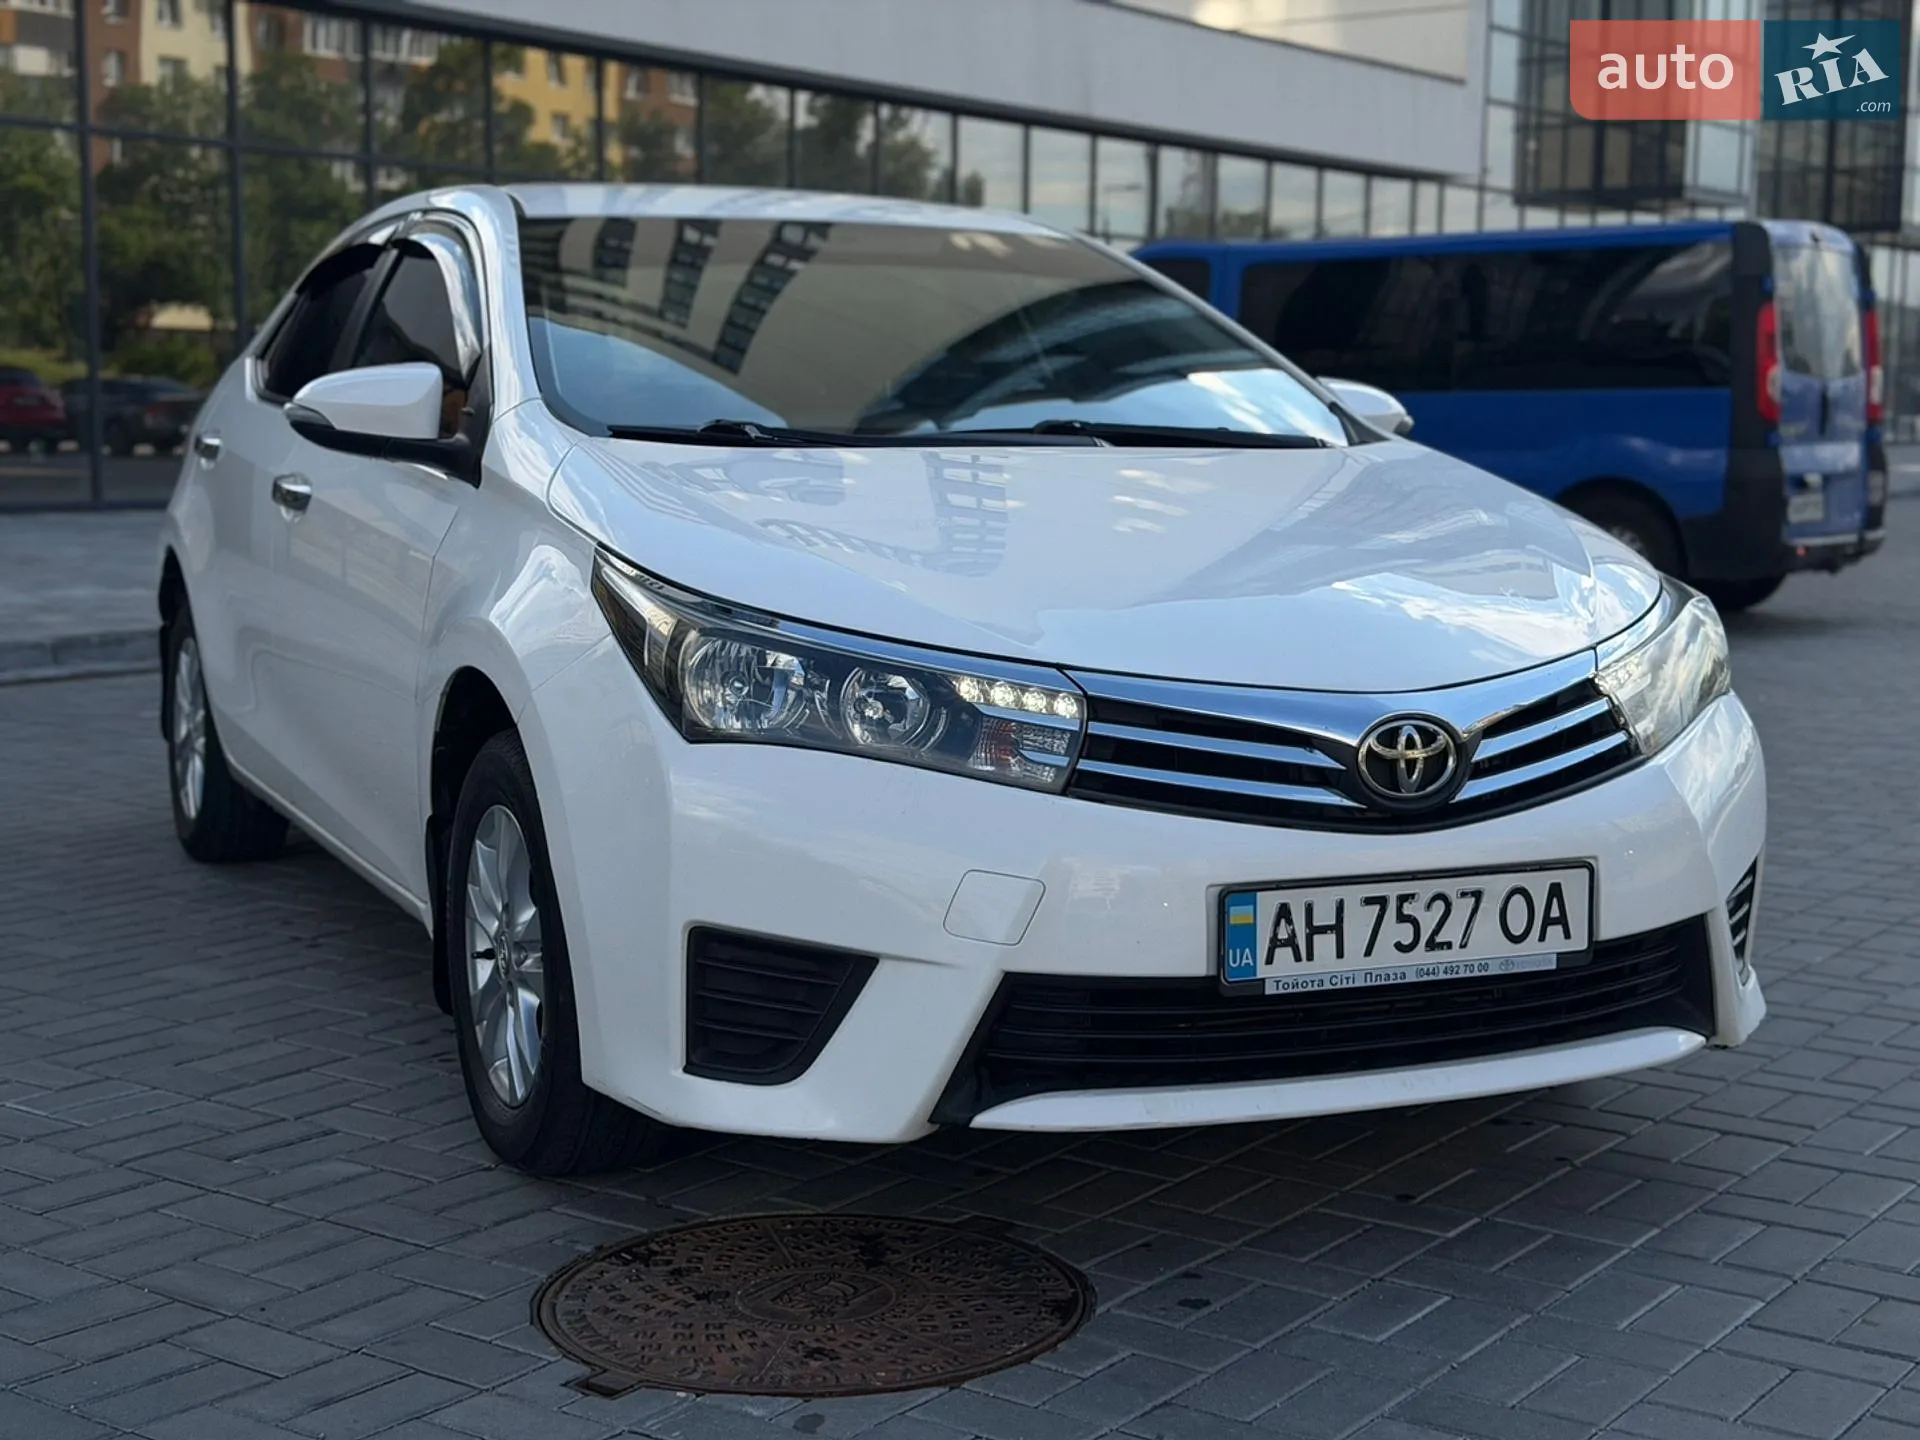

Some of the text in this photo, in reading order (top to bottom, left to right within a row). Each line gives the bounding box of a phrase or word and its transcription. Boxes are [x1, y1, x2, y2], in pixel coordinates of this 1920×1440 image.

[1264, 881, 1572, 966] AH 7527 OA
[1228, 947, 1254, 968] UA
[1273, 961, 1490, 992] Тойота Сіті Плаза (044) 492 70 00
